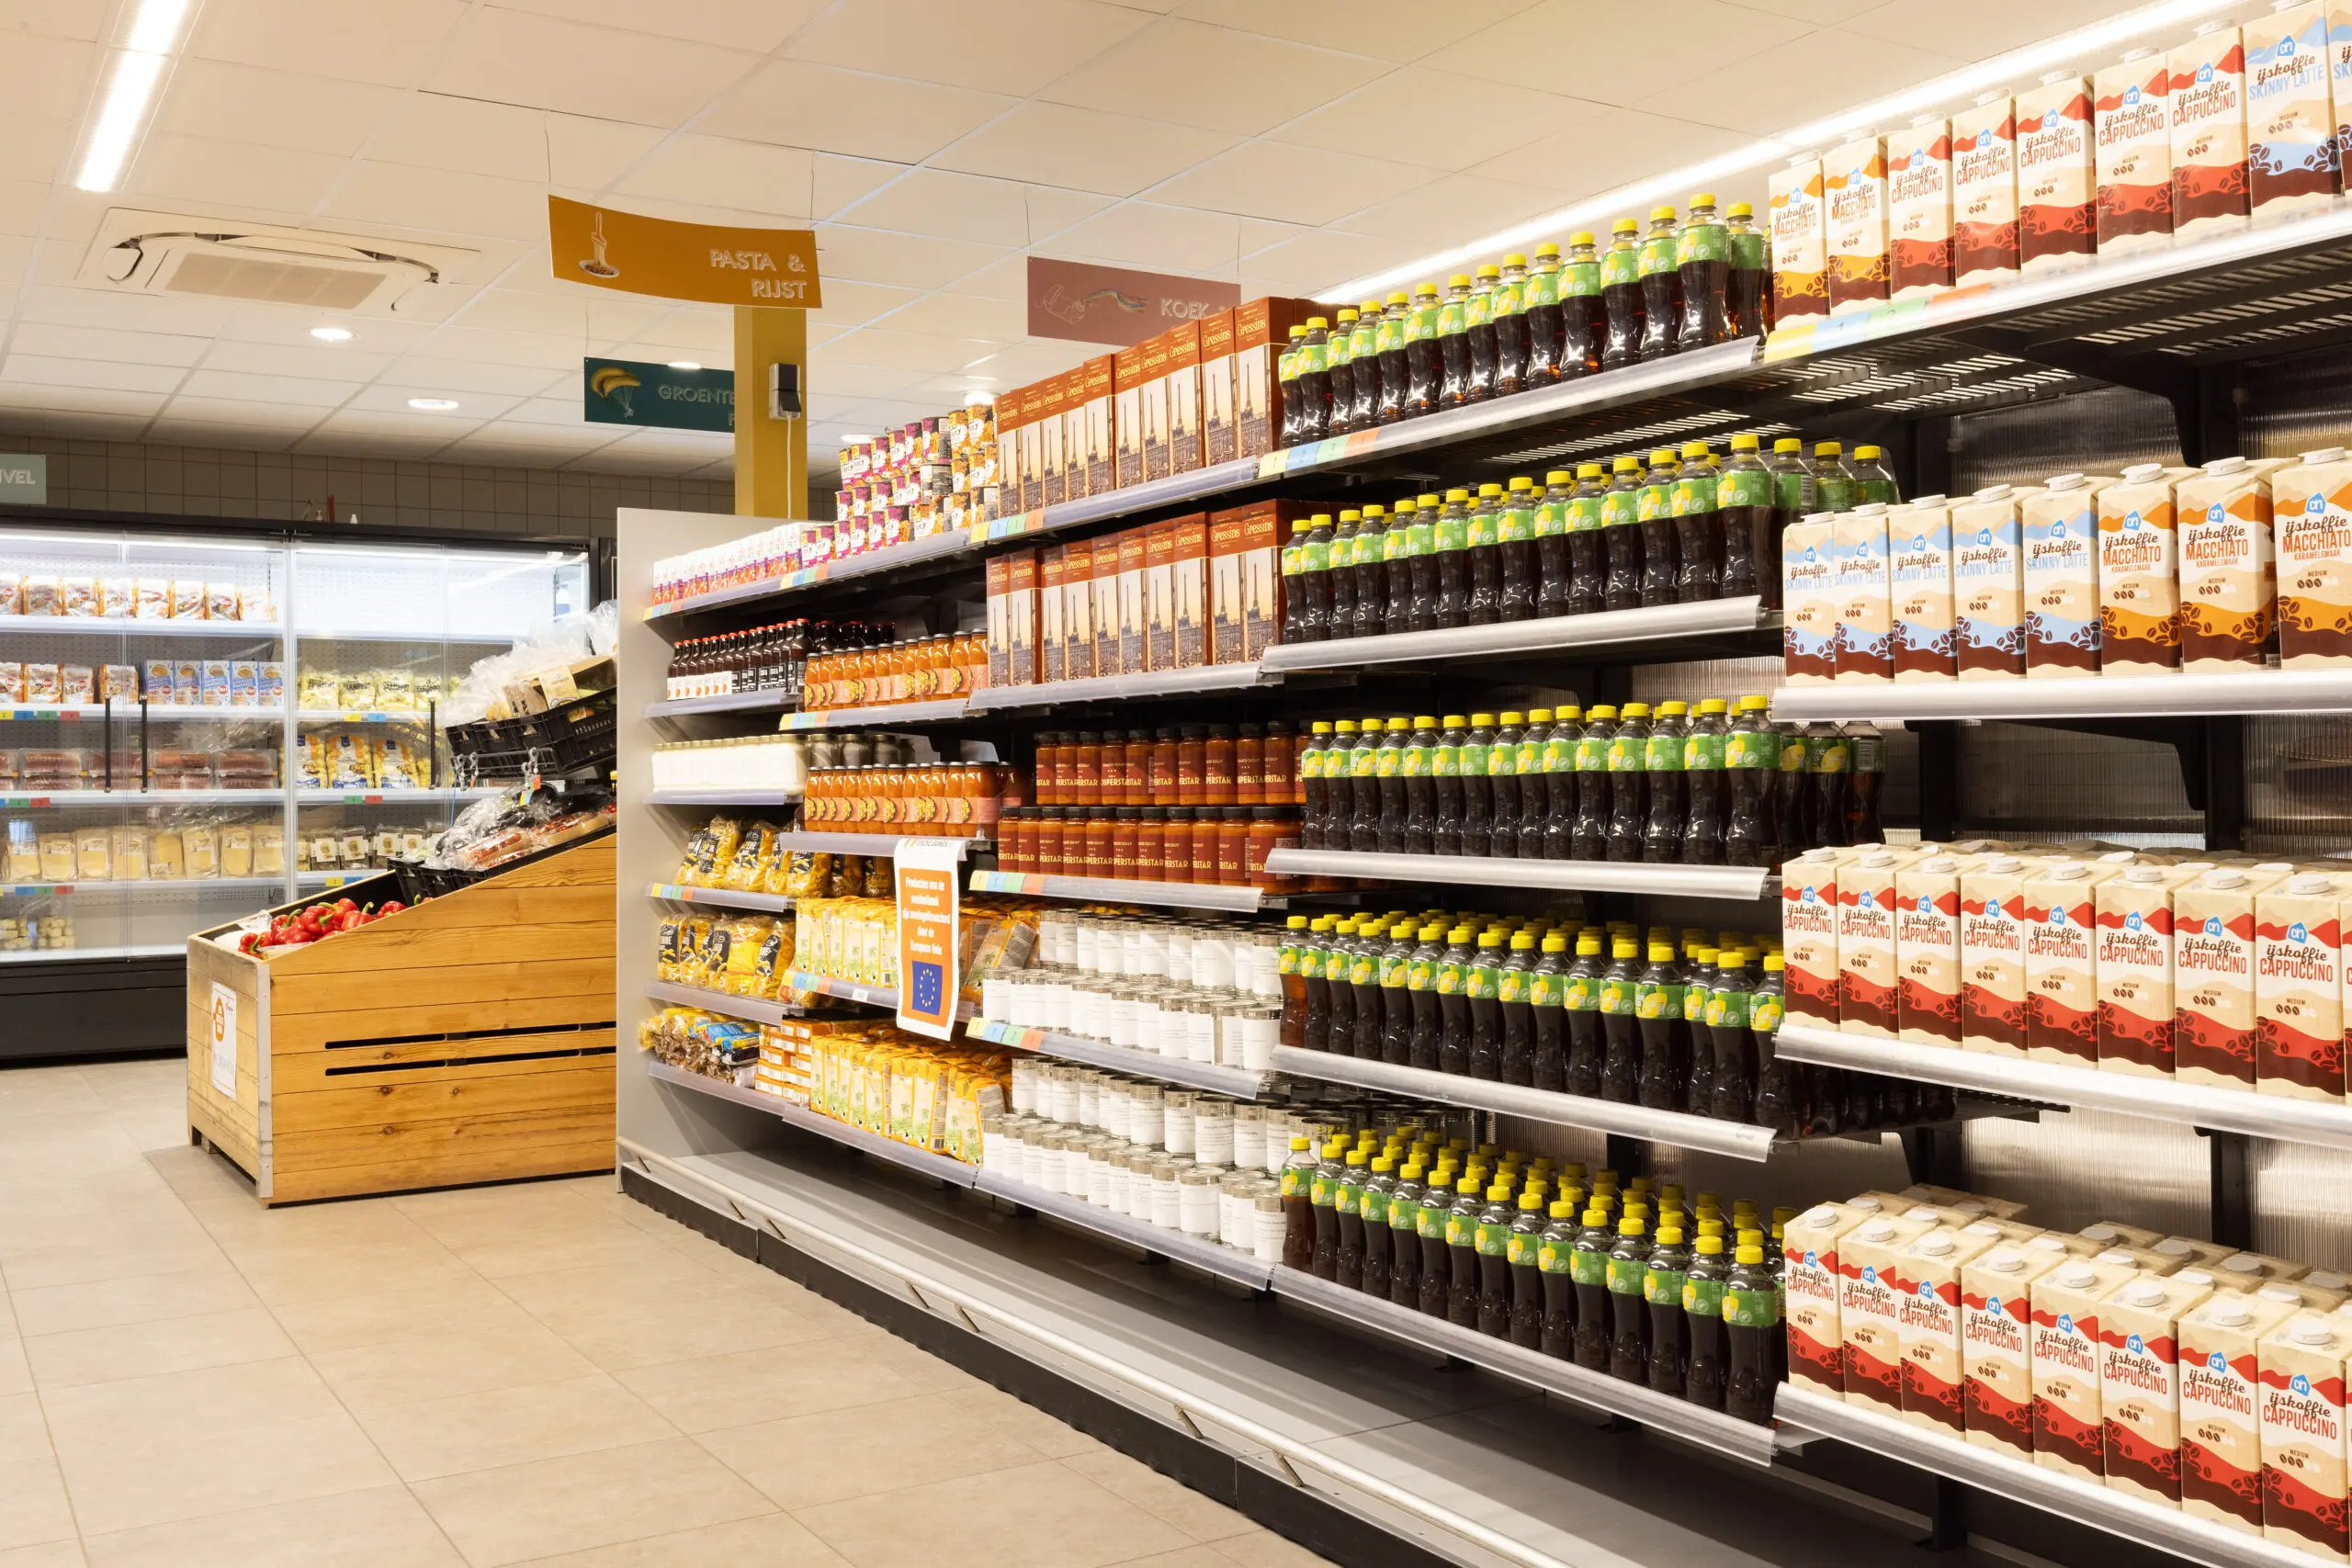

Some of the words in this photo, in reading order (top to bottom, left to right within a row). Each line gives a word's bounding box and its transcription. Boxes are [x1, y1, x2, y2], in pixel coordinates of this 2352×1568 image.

[2256, 54, 2316, 85] ijskoffie
[2248, 78, 2290, 101] SKINNY
[2293, 64, 2324, 92] LATTE
[2178, 81, 2231, 109] ijskoffie
[2105, 104, 2158, 130] ijskoffie
[2173, 91, 2236, 126] CAPPUCCINO
[2026, 127, 2075, 152] ijskoffie
[2099, 113, 2164, 146] CAPPUCCINO
[1962, 146, 2007, 169] ijskoffie
[2021, 137, 2081, 167] CAPPUCCINO
[1895, 166, 1938, 190] ijskoffie
[1956, 157, 2010, 185] CAPPUCCINO
[1833, 185, 1873, 207] ijskoffie
[1892, 175, 1943, 203] CAPPUCCINO
[1775, 203, 1815, 222] ijskoffie
[1831, 194, 1876, 220] MACCHIATO
[1774, 213, 1816, 236] MACCHIATO
[709, 248, 776, 271] PASTA
[788, 254, 807, 272] &
[751, 279, 807, 299] RIJST
[1160, 298, 1209, 319] KOEK
[2188, 525, 2245, 545] ijskoffie
[2285, 516, 2347, 537] ijskoffie
[2032, 541, 2082, 558] ijskoffie
[2106, 534, 2158, 551] ijskoffie
[2186, 539, 2248, 560] MACCHIATO
[2282, 529, 2351, 554] MACCHIATO
[1840, 560, 1880, 575] ijskoffie
[1897, 554, 1940, 570] ijskoffie
[1962, 548, 2007, 565] ijskoffie
[2026, 556, 2061, 570] SKINNY
[2064, 552, 2087, 568] LATTE
[2103, 546, 2161, 567] MACCHIATO
[1791, 565, 1828, 580] ijskoffie
[1892, 568, 1921, 582] SKINNY
[1924, 565, 1947, 580] LATTE
[1955, 563, 1987, 578] SKINNY
[1990, 560, 2013, 575] LATTE
[1787, 904, 1828, 919] ijskoffie
[1845, 909, 1886, 924] ijskoffie
[1904, 915, 1947, 930] ijskoffie
[1784, 916, 1832, 933] CAPPUCCINO
[1840, 920, 1890, 940] CAPPUCCINO
[1970, 919, 2015, 935] ijskoffie
[2033, 927, 2082, 944] ijskoffie
[1899, 927, 1951, 945] CAPPUCCINO
[1964, 931, 2019, 951] CAPPUCCINO
[2106, 932, 2158, 950] ijskoffie
[2029, 939, 2086, 959] CAPPUCCINO
[2099, 945, 2164, 966] CAPPUCCINO
[2185, 938, 2243, 957] ijskoffie
[2267, 944, 2327, 964] ijskoffie
[2178, 952, 2246, 975] CAPPUCCINO
[2260, 958, 2333, 982] CAPPUCCINO
[1792, 1267, 1830, 1288] ijskoffie
[1787, 1277, 1835, 1301] CAPPUCCINO
[1848, 1282, 1891, 1303] ijskoffie
[1843, 1292, 1895, 1318] CAPPUCCINO
[1904, 1297, 1948, 1319] ijskoffie
[1900, 1308, 1953, 1335] CAPPUCCINO
[1970, 1313, 2018, 1335] ijskoffie
[1965, 1324, 2022, 1352] CAPPUCCINO
[2040, 1330, 2089, 1354] ijskoffie
[2035, 1341, 2094, 1372] CAPPUCCINO
[2109, 1351, 2161, 1375] ijskoffie
[2104, 1363, 2167, 1394] CAPPUCCINO
[2189, 1370, 2245, 1393] ijskoffie
[2183, 1382, 2251, 1416] CAPPUCCINO
[2269, 1393, 2331, 1417] ijskoffie
[2263, 1404, 2336, 1439] CAPPUCCINO
